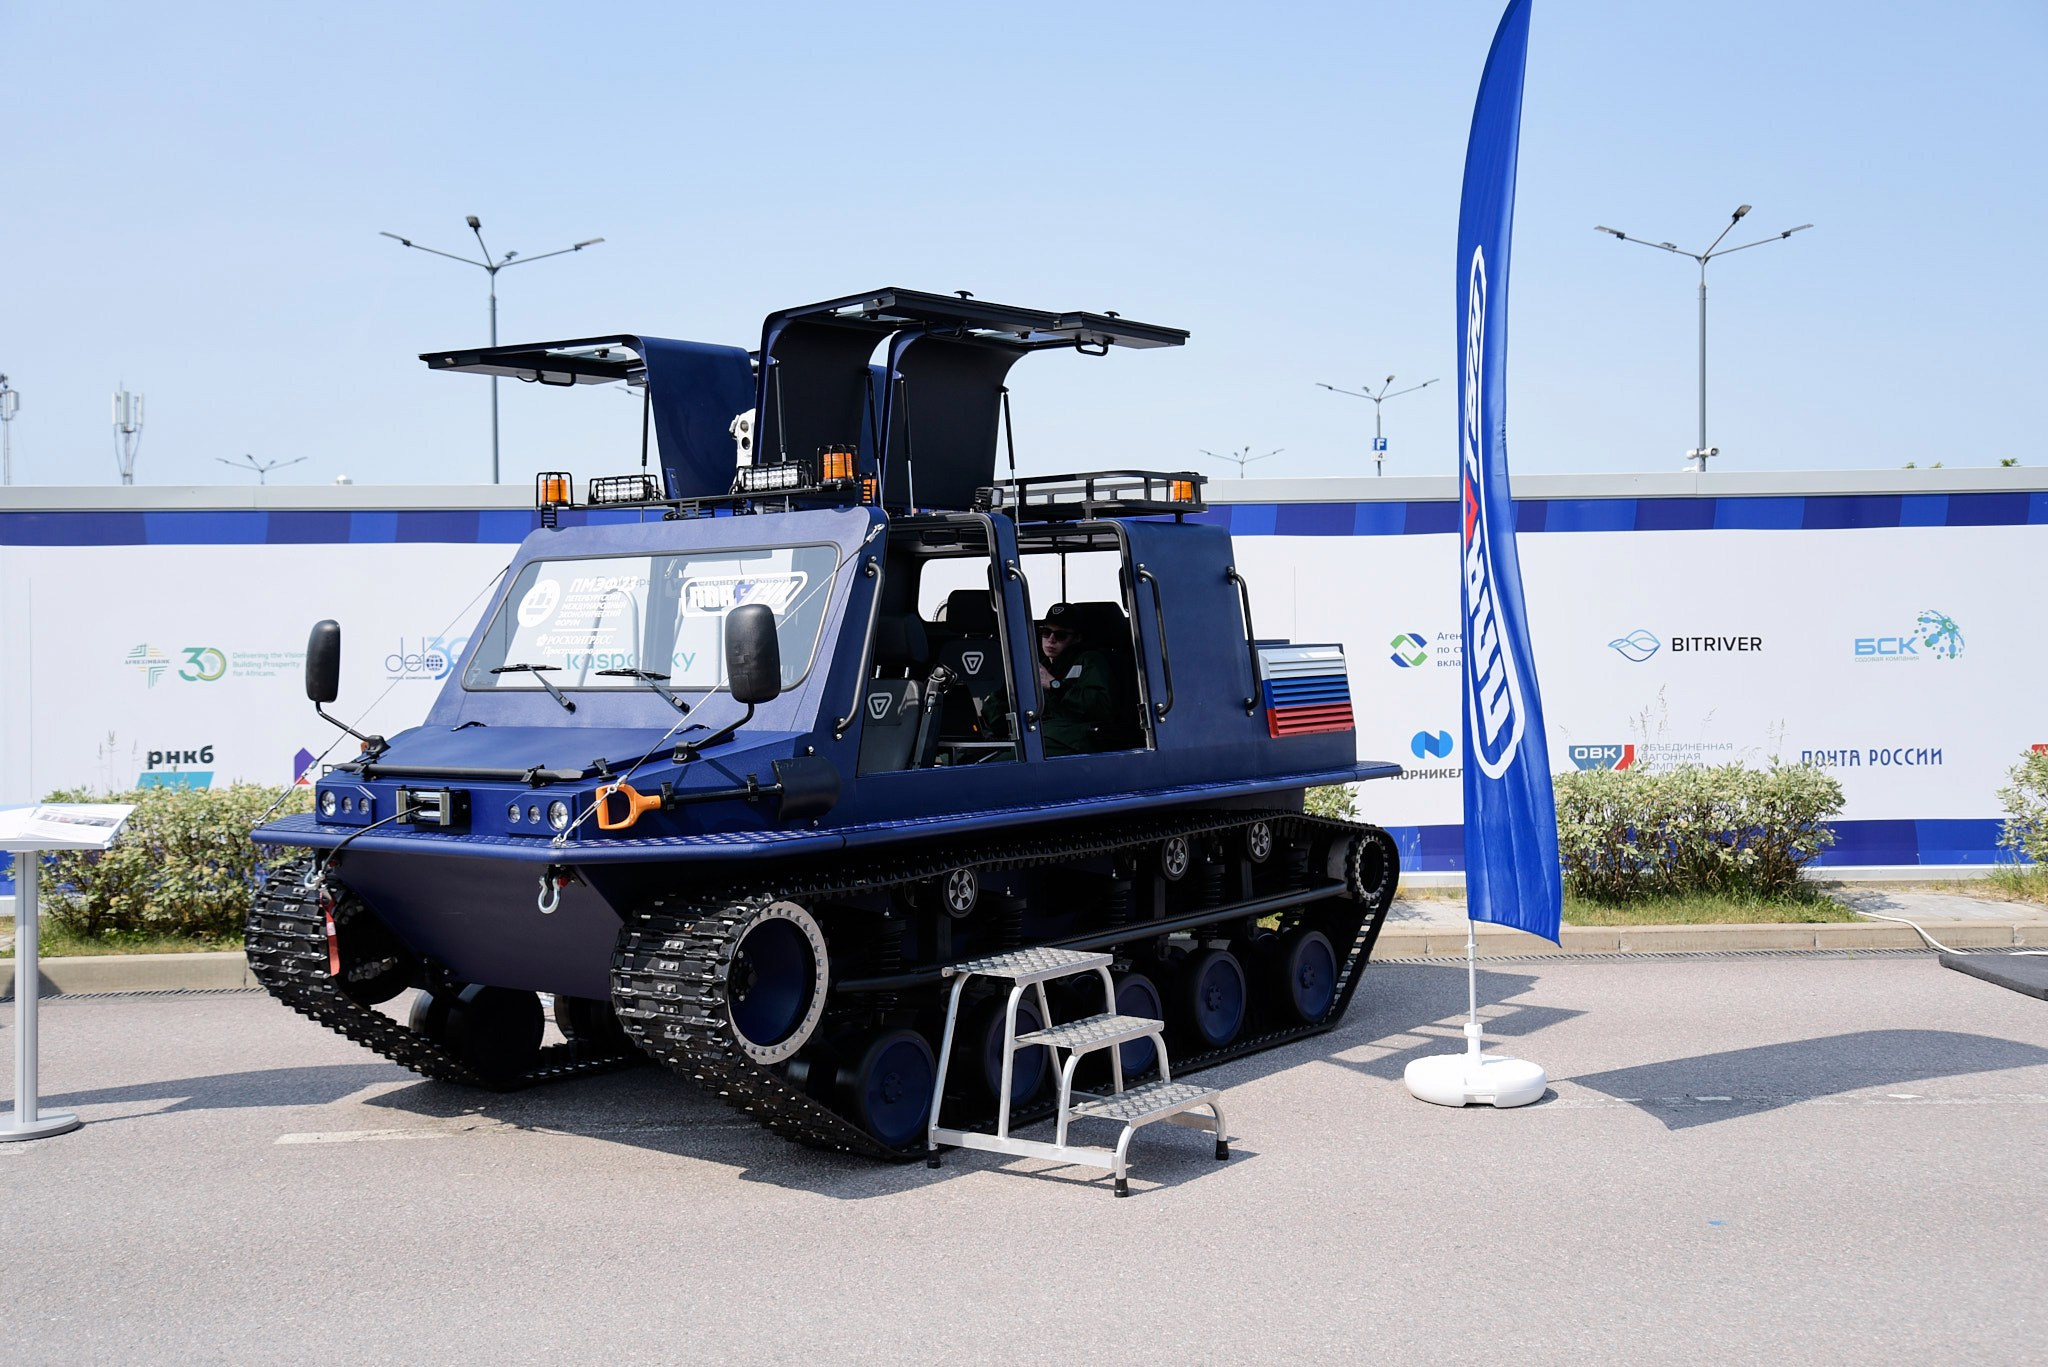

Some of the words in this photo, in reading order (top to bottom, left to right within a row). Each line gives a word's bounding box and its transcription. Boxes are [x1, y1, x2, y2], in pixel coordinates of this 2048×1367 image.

[562, 601, 628, 610] МЕЖДУНАРОДНЫЙ
[558, 609, 623, 618] ЭКОНОМИЧЕСКИЙ
[555, 618, 581, 626] ФОРУМ
[547, 635, 614, 645] РОСКОНГРЕСС
[1437, 632, 1462, 641] Аген
[1672, 637, 1763, 651] BITRIVER
[1854, 637, 1919, 656] БСК
[232, 652, 269, 660] Delivering
[178, 647, 227, 681] 30
[232, 661, 262, 670] Building
[263, 661, 301, 669] Prosperity
[1437, 659, 1461, 667] вкла
[1641, 743, 1733, 752] ОБЪЕДИНЕННАЯ
[147, 745, 214, 769] рнкб
[1574, 747, 1617, 759] ОВК
[1641, 753, 1701, 761] ВАГОННАЯ
[1801, 750, 1861, 767] ПОЧТА
[1869, 748, 1943, 766] РОССИИ
